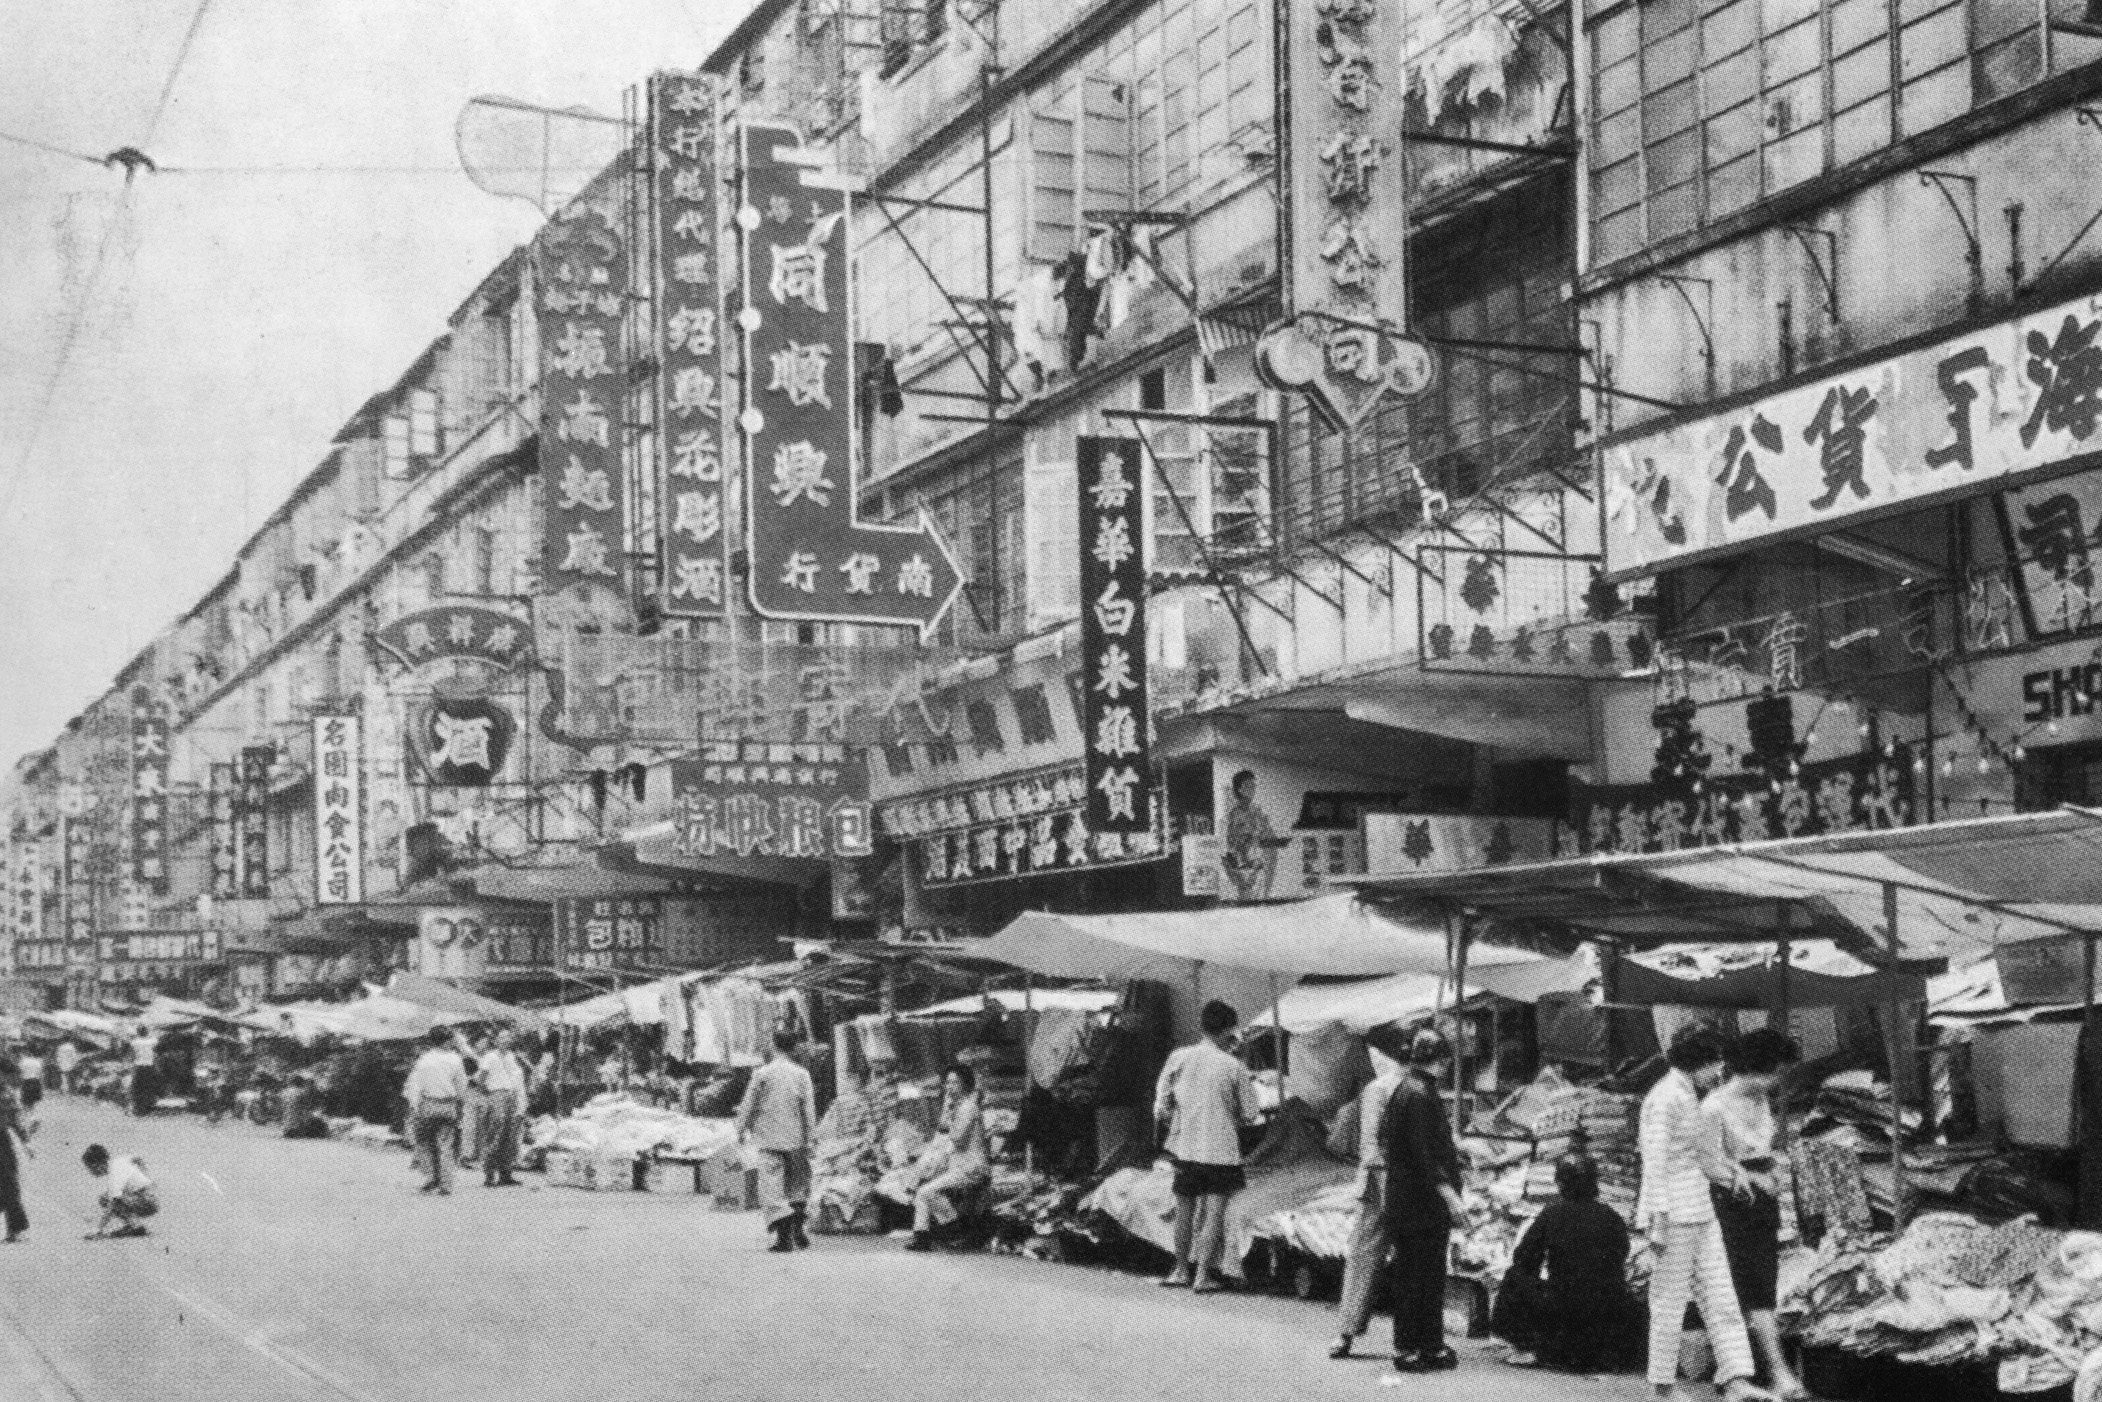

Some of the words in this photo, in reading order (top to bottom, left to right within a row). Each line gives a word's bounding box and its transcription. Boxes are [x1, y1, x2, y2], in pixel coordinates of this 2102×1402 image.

[1088, 451, 1140, 823] 嘉華白米雜貨
[322, 718, 351, 901] 名園肉食公司
